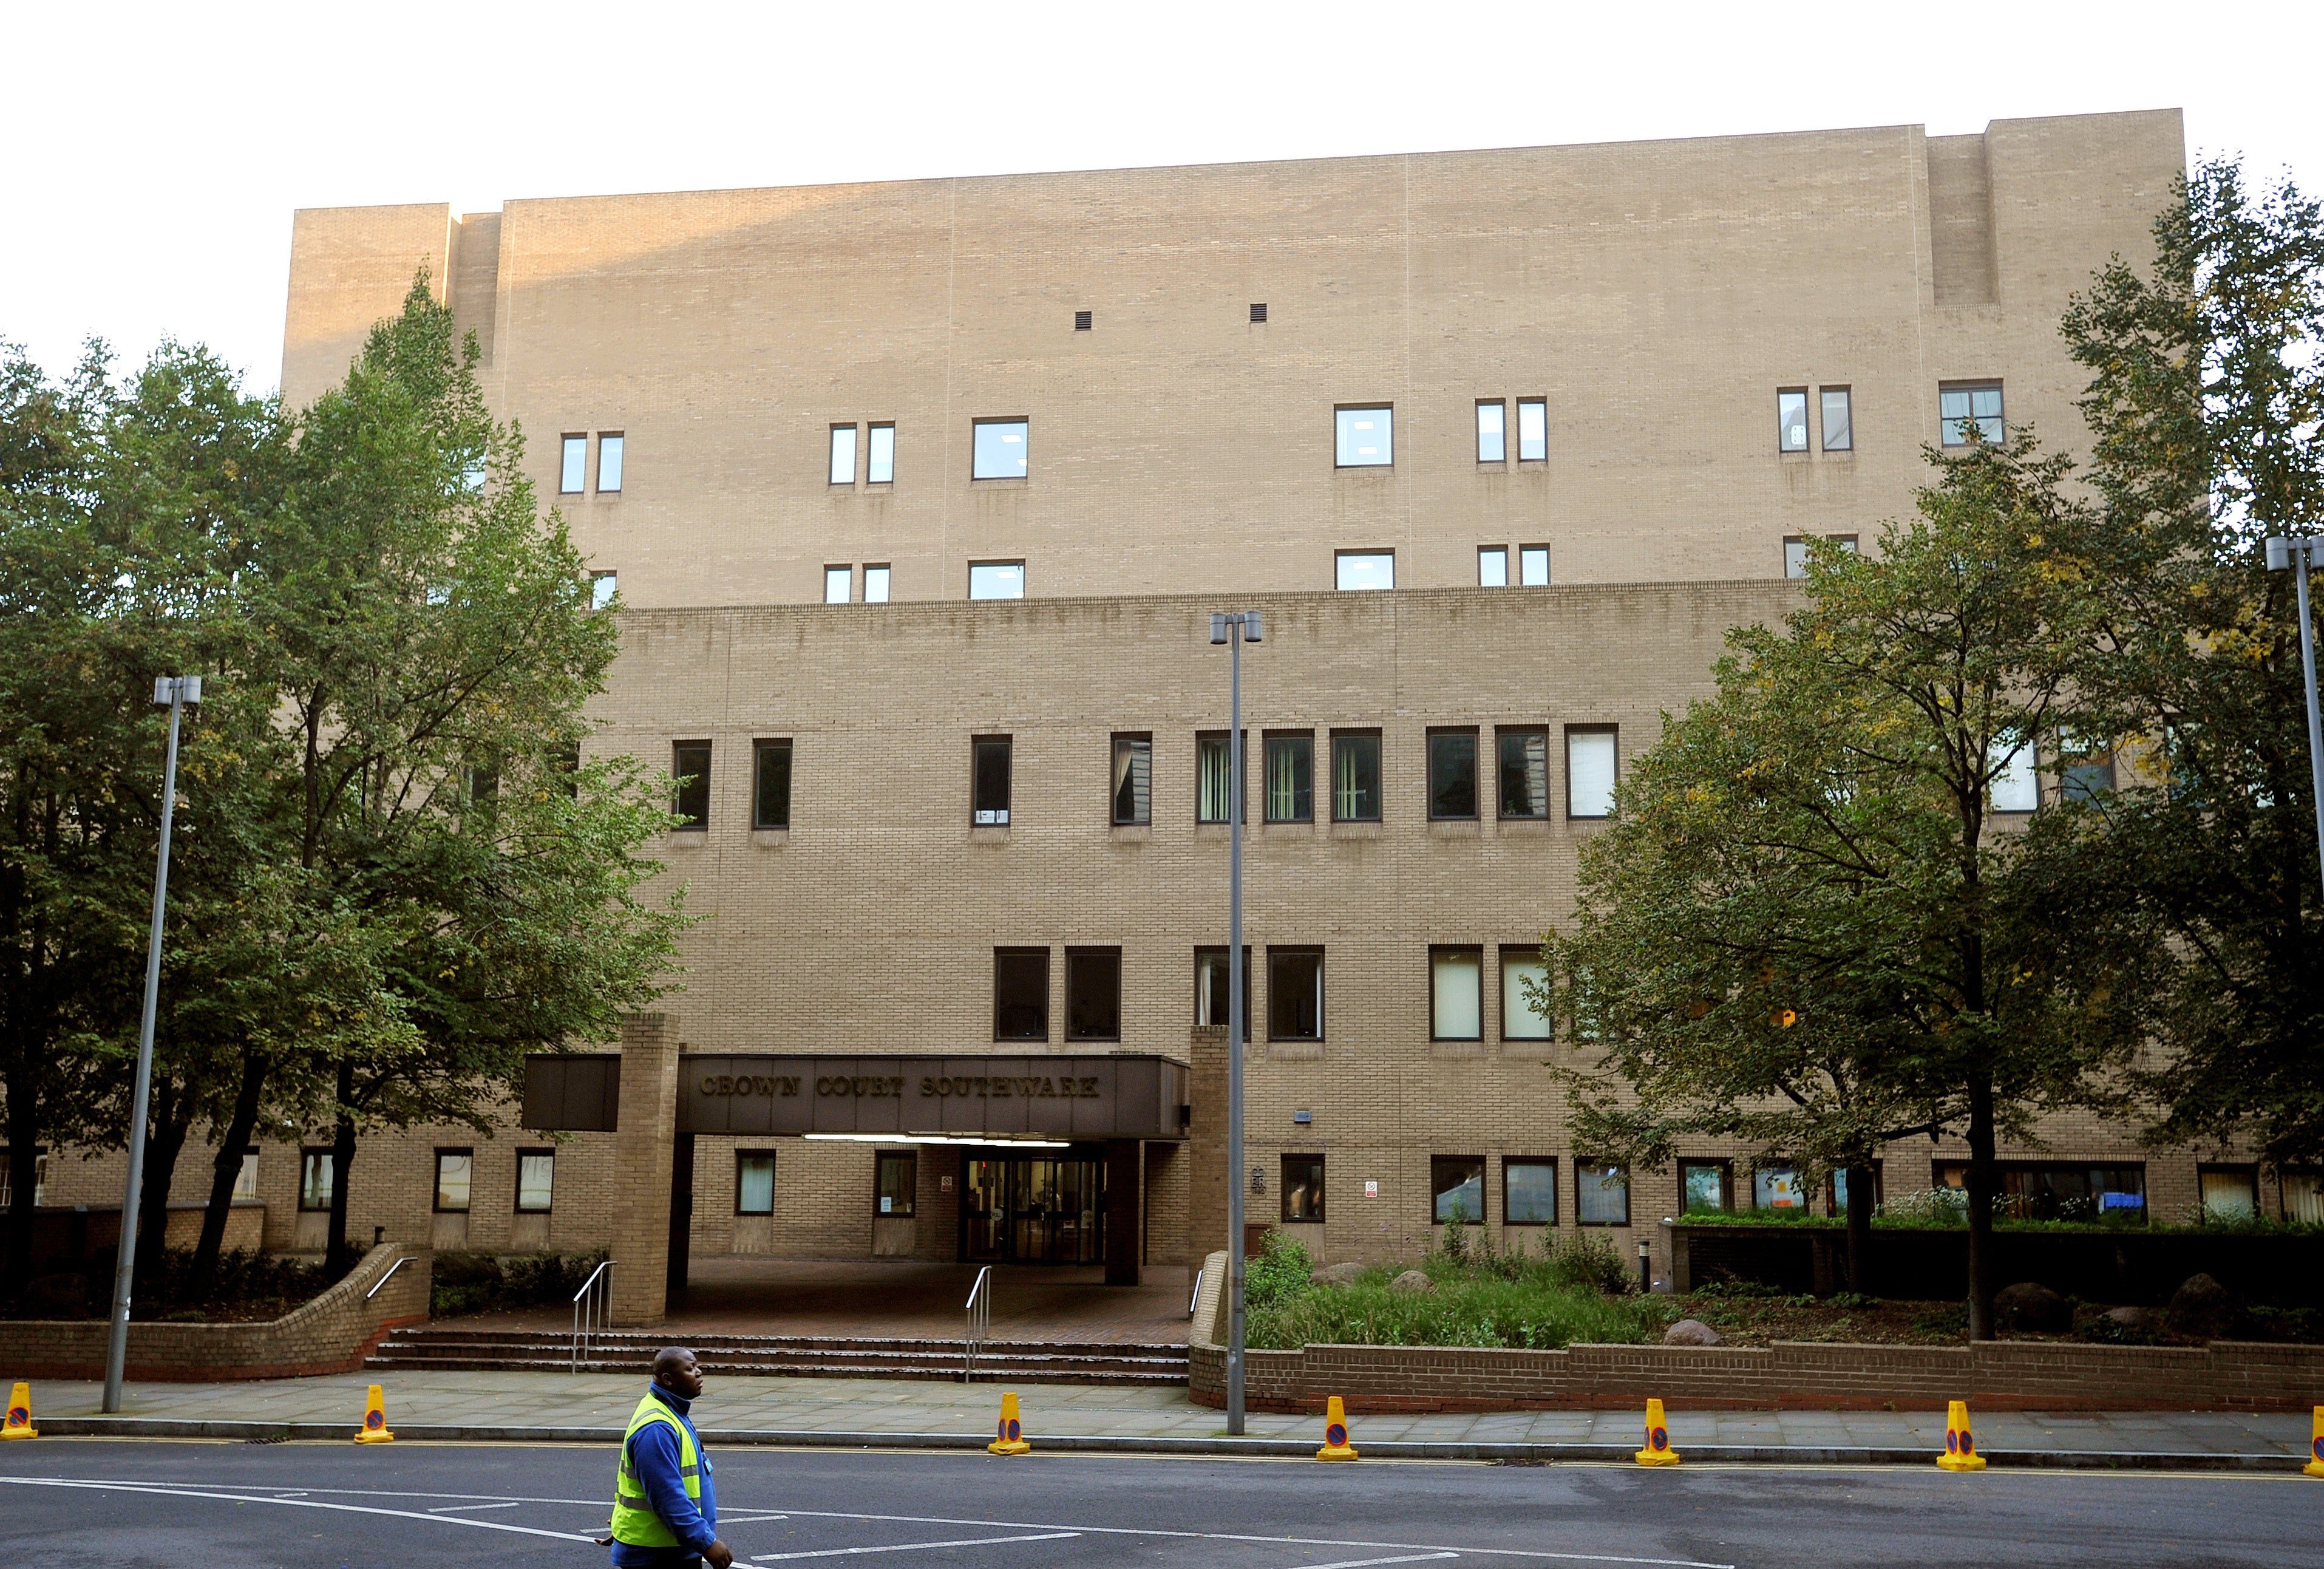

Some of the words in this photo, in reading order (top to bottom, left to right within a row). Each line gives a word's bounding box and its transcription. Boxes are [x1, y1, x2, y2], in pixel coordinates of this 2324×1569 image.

[700, 1075, 801, 1095] CROWN
[817, 1075, 905, 1096] COURT
[920, 1076, 1100, 1097] SOUTHWARK
[1251, 1177, 1266, 1188] ER
